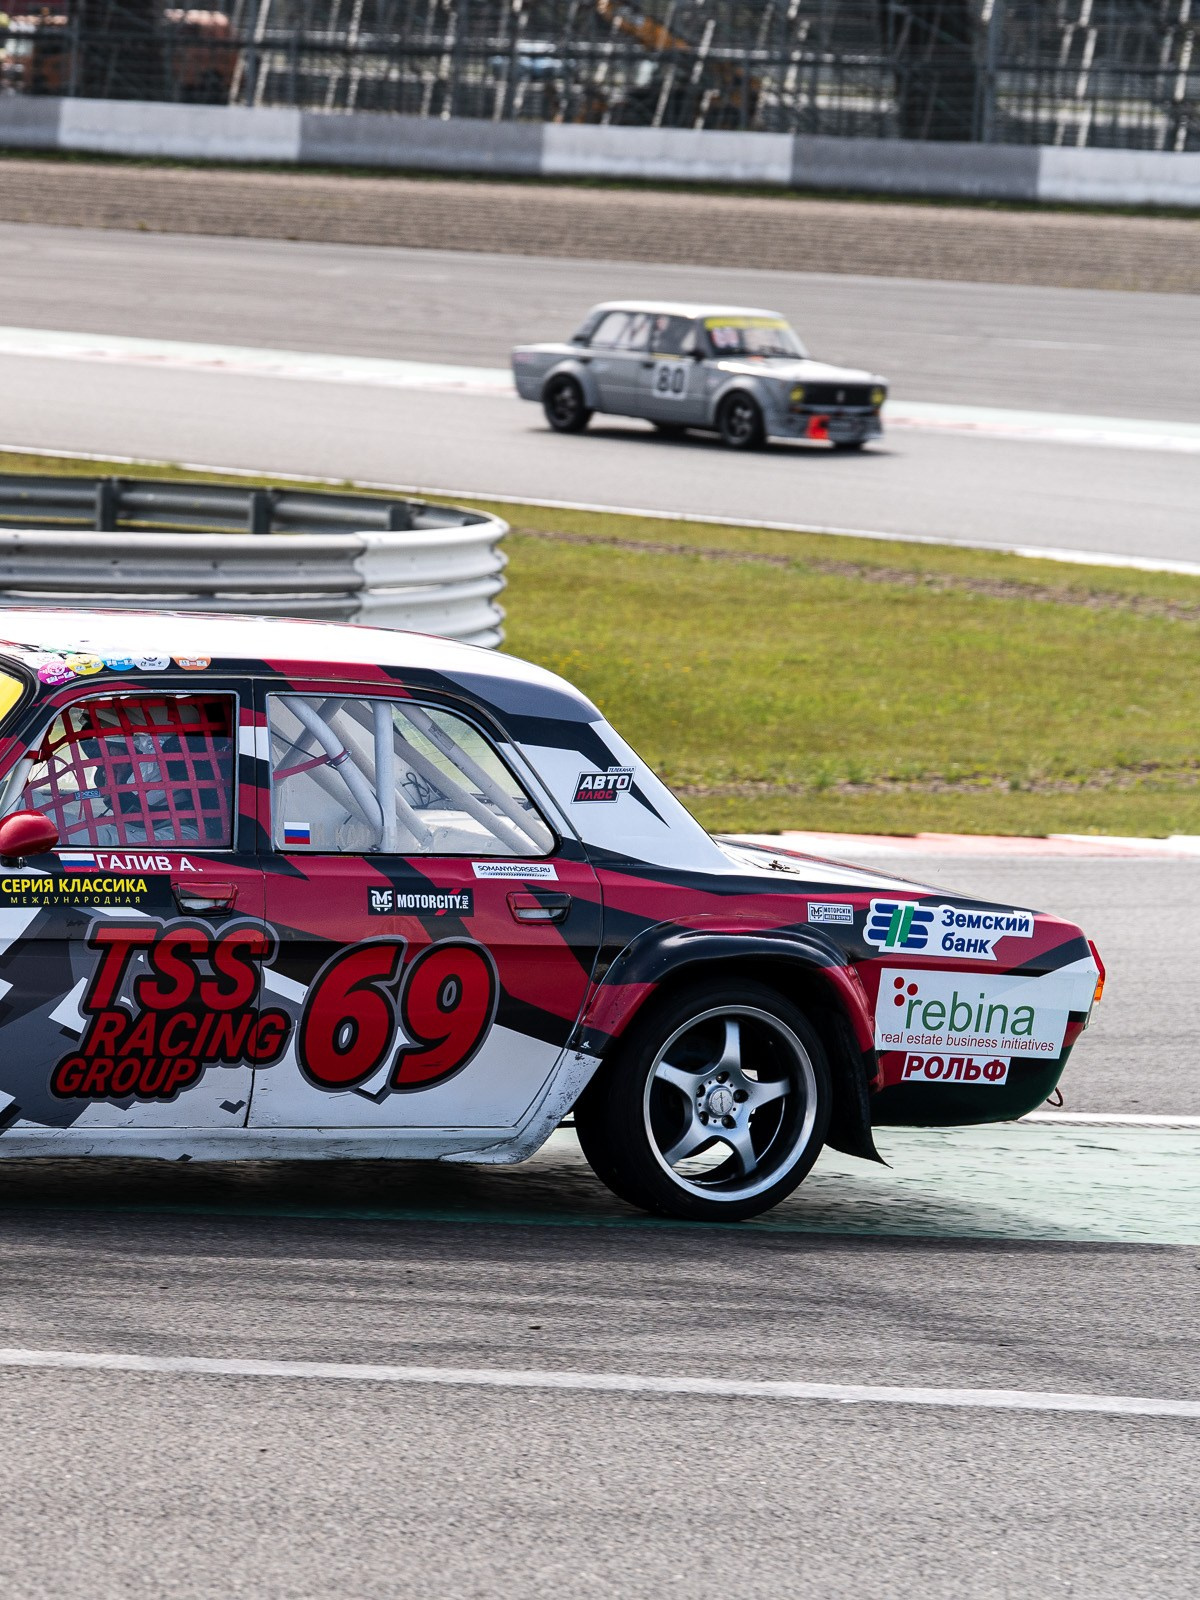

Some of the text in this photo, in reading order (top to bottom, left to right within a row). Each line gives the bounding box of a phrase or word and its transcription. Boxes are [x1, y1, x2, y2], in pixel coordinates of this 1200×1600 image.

[657, 366, 685, 393] 80
[579, 775, 630, 790] АВТО
[577, 790, 614, 800] ПЛЮС
[95, 855, 173, 872] ГАЛИВ
[1, 878, 148, 893] СЕРИЯ КЛАССИКА
[10, 896, 142, 905] МЕЖДУНАРОДНАЯ
[941, 909, 1030, 932] Земский
[941, 932, 992, 954] банк
[87, 926, 271, 1012] TSS
[301, 941, 494, 1087] 69
[905, 991, 1036, 1036] rebina
[84, 1011, 286, 1060] RACING
[880, 1031, 1055, 1052] real estate business initiatives
[55, 1057, 197, 1093] GROUP
[903, 1055, 1007, 1082] РОЛЬФ
